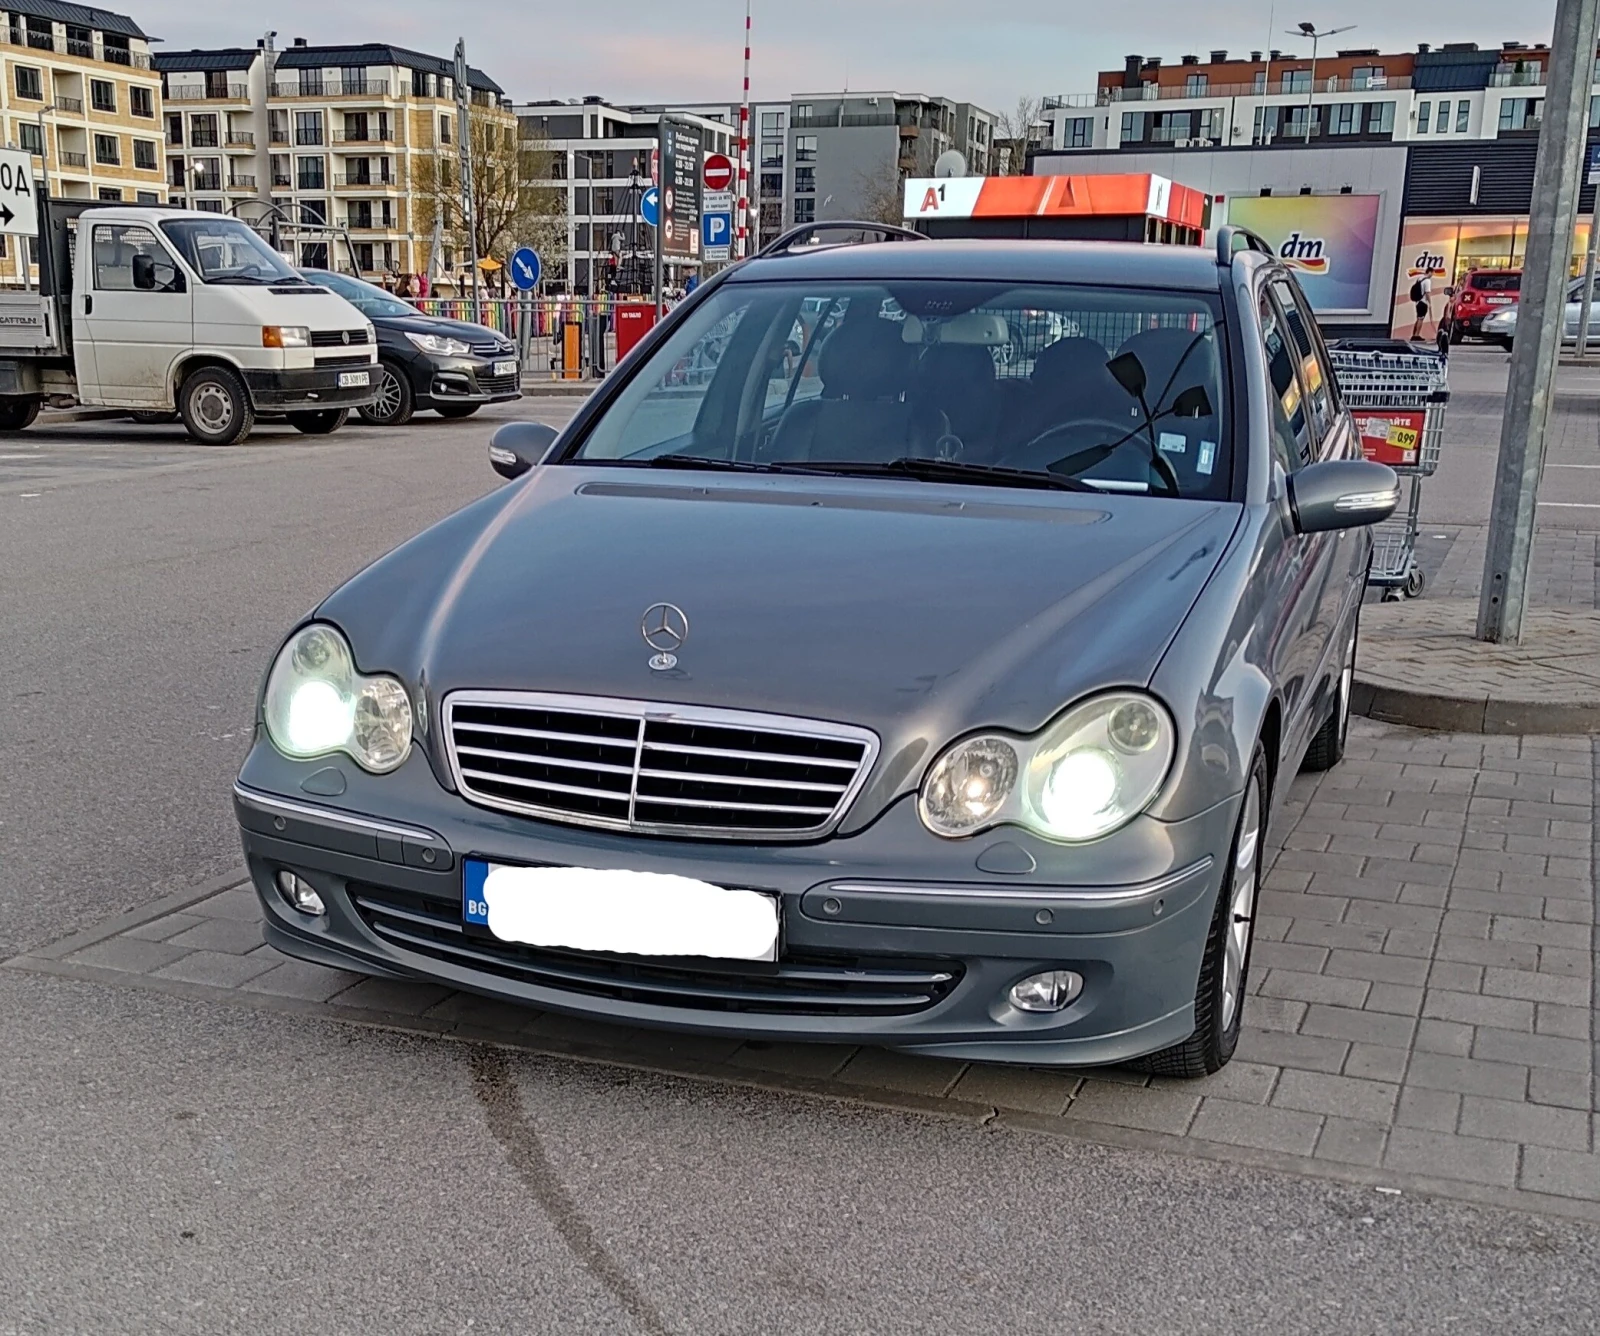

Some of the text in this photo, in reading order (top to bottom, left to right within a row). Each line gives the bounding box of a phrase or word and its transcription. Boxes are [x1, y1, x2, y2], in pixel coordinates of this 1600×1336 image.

[0, 163, 30, 197] ОД
[920, 183, 946, 212] A1
[710, 217, 725, 242] P
[1280, 234, 1323, 258] dm
[1415, 251, 1443, 268] dm
[1397, 431, 1415, 446] 0.99
[468, 899, 487, 917] BG
